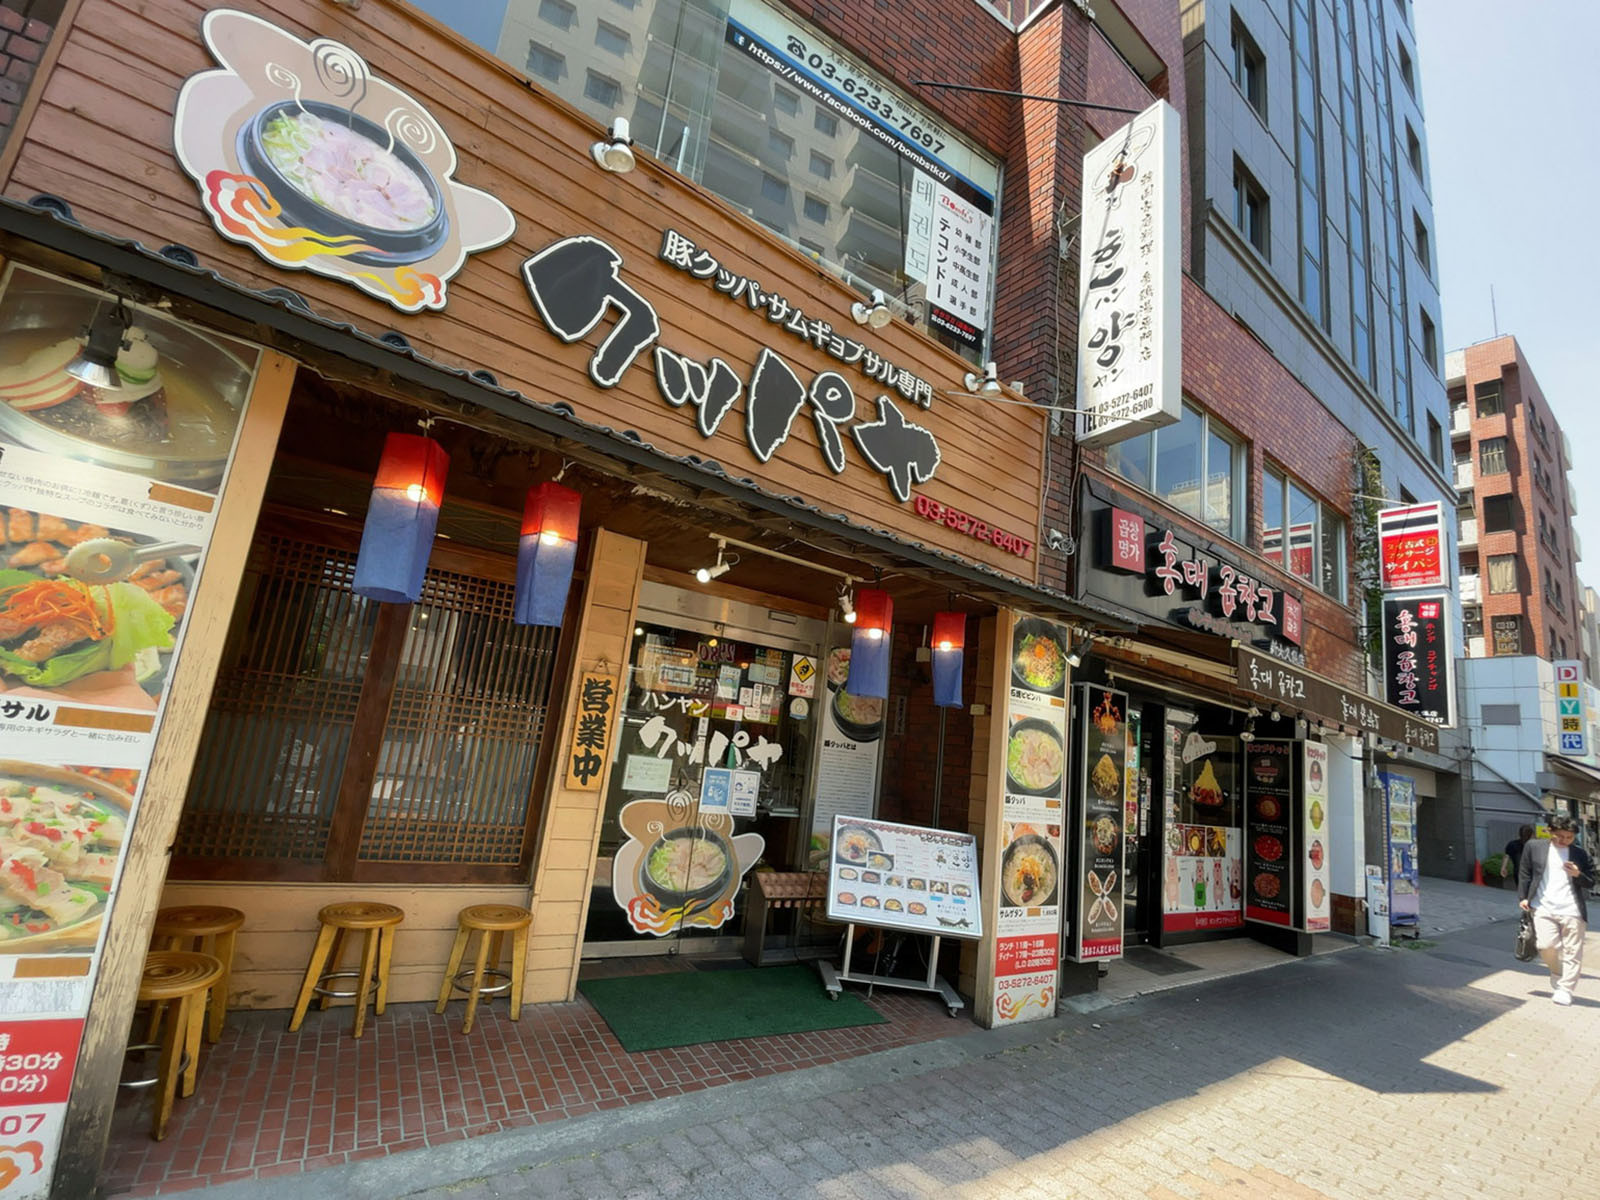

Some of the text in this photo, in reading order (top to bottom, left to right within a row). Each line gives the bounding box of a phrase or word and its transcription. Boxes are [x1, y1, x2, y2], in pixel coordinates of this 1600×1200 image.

[748, 42, 951, 182] https://www.facebook.com/bombstkd/
[808, 52, 946, 155] 03-6233-7697
[906, 178, 934, 274] 태권도
[936, 216, 951, 299] テコンドー
[660, 229, 934, 410] 豚クッパ・サムギョプサル専門
[520, 235, 943, 503] クッパヤ
[1098, 383, 1154, 414] 03-5272-6407
[914, 494, 1033, 559] 03-5272-6407
[1156, 530, 1208, 600] 홍대
[573, 678, 613, 786] 営業中
[638, 716, 783, 771] クッパヤ
[641, 692, 709, 714] ハンヤン
